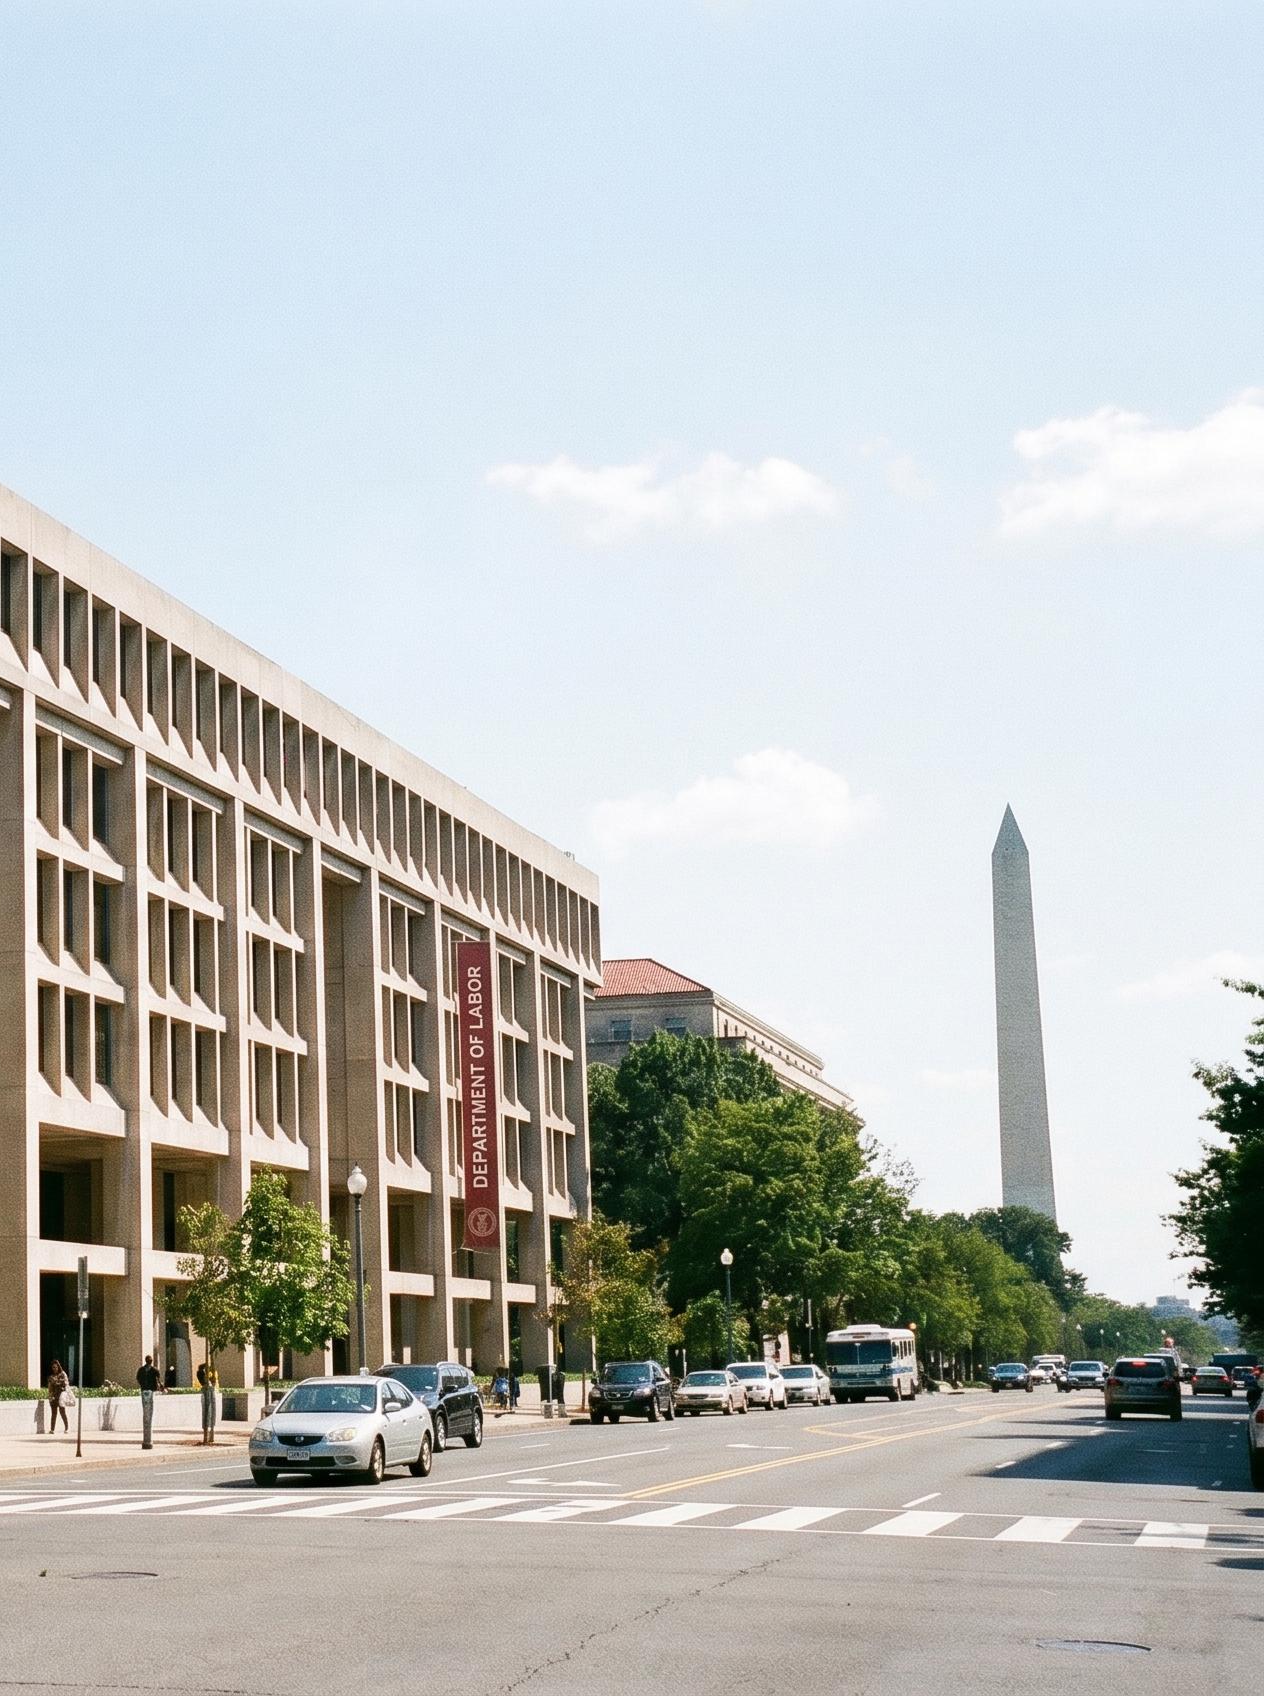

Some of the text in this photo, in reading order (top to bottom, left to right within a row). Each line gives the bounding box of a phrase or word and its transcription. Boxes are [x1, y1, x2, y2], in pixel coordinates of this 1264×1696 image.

[467, 966, 484, 1029] LABOR
[469, 1034, 485, 1059] OF
[470, 1063, 488, 1188] DEPARTMENT
